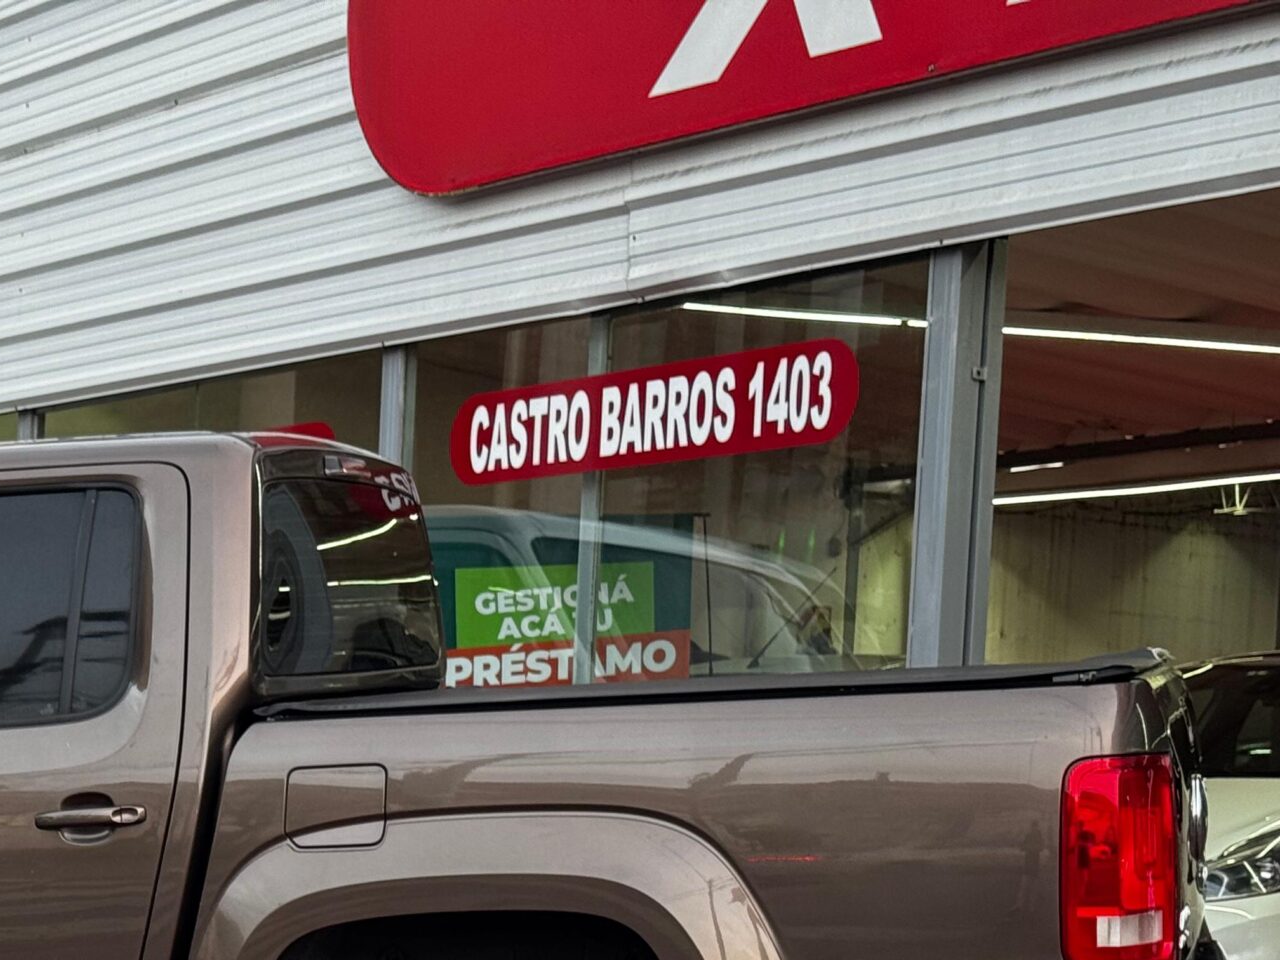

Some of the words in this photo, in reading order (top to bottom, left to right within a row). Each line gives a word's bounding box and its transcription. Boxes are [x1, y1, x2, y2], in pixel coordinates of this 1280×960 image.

[469, 390, 590, 474] CASTRO
[599, 367, 736, 458] BARROS
[748, 351, 833, 437] 1403
[571, 607, 614, 638] U
